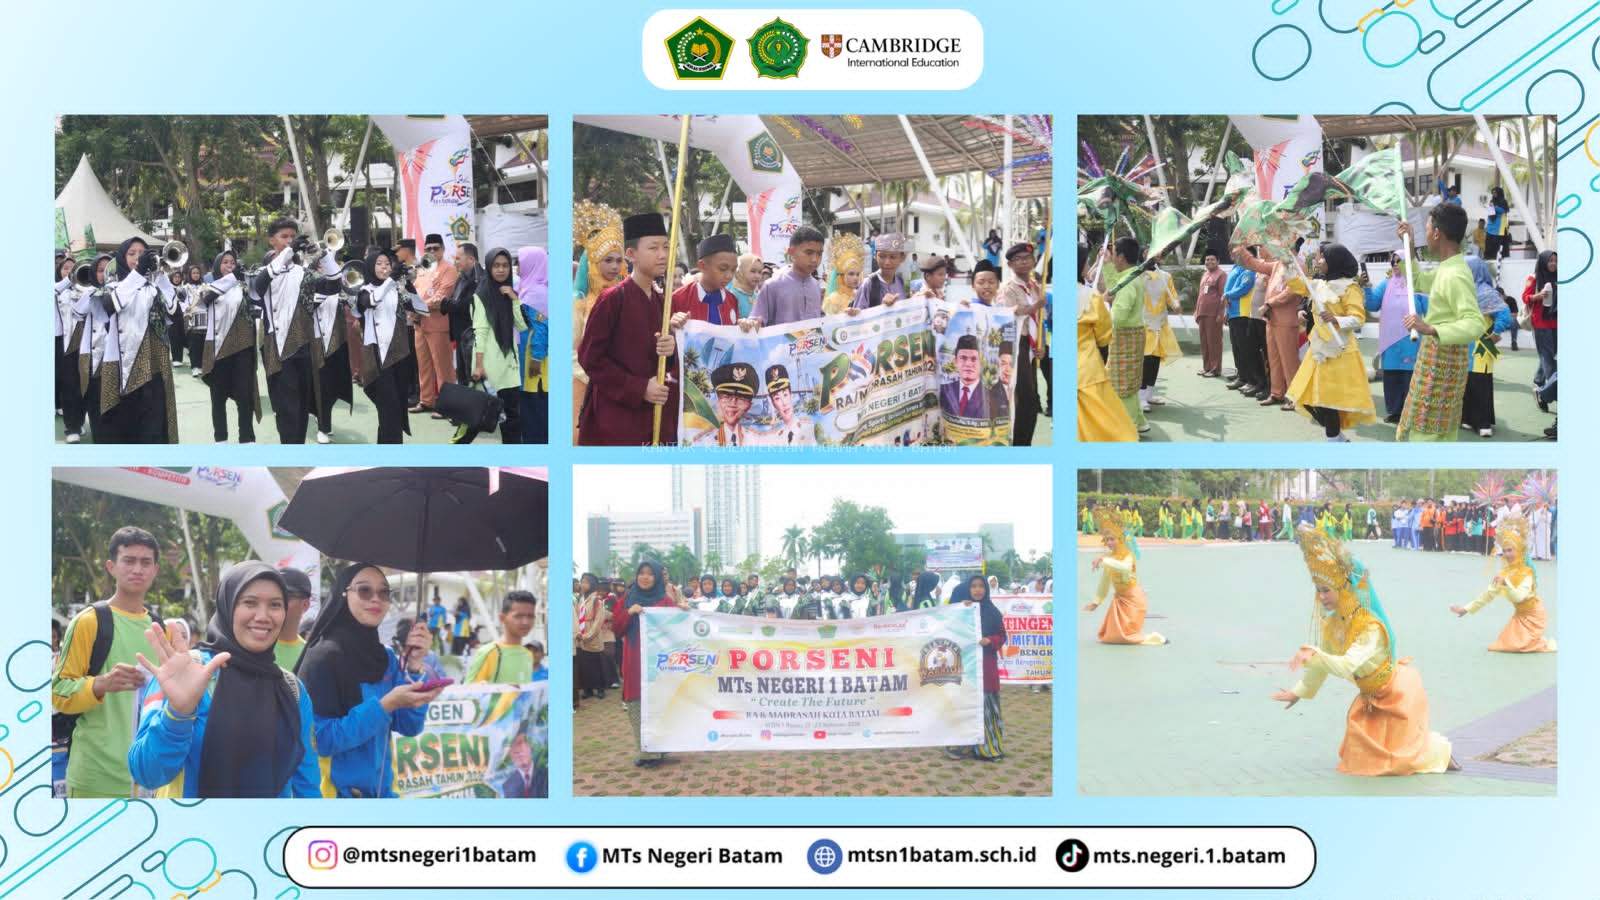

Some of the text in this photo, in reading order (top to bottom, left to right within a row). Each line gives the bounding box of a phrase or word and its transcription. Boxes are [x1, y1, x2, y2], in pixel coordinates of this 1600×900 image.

[728, 647, 896, 672] PORSENI
[718, 675, 908, 694] MTs NEGERI 1 BATAM
[424, 704, 463, 721] GEN
